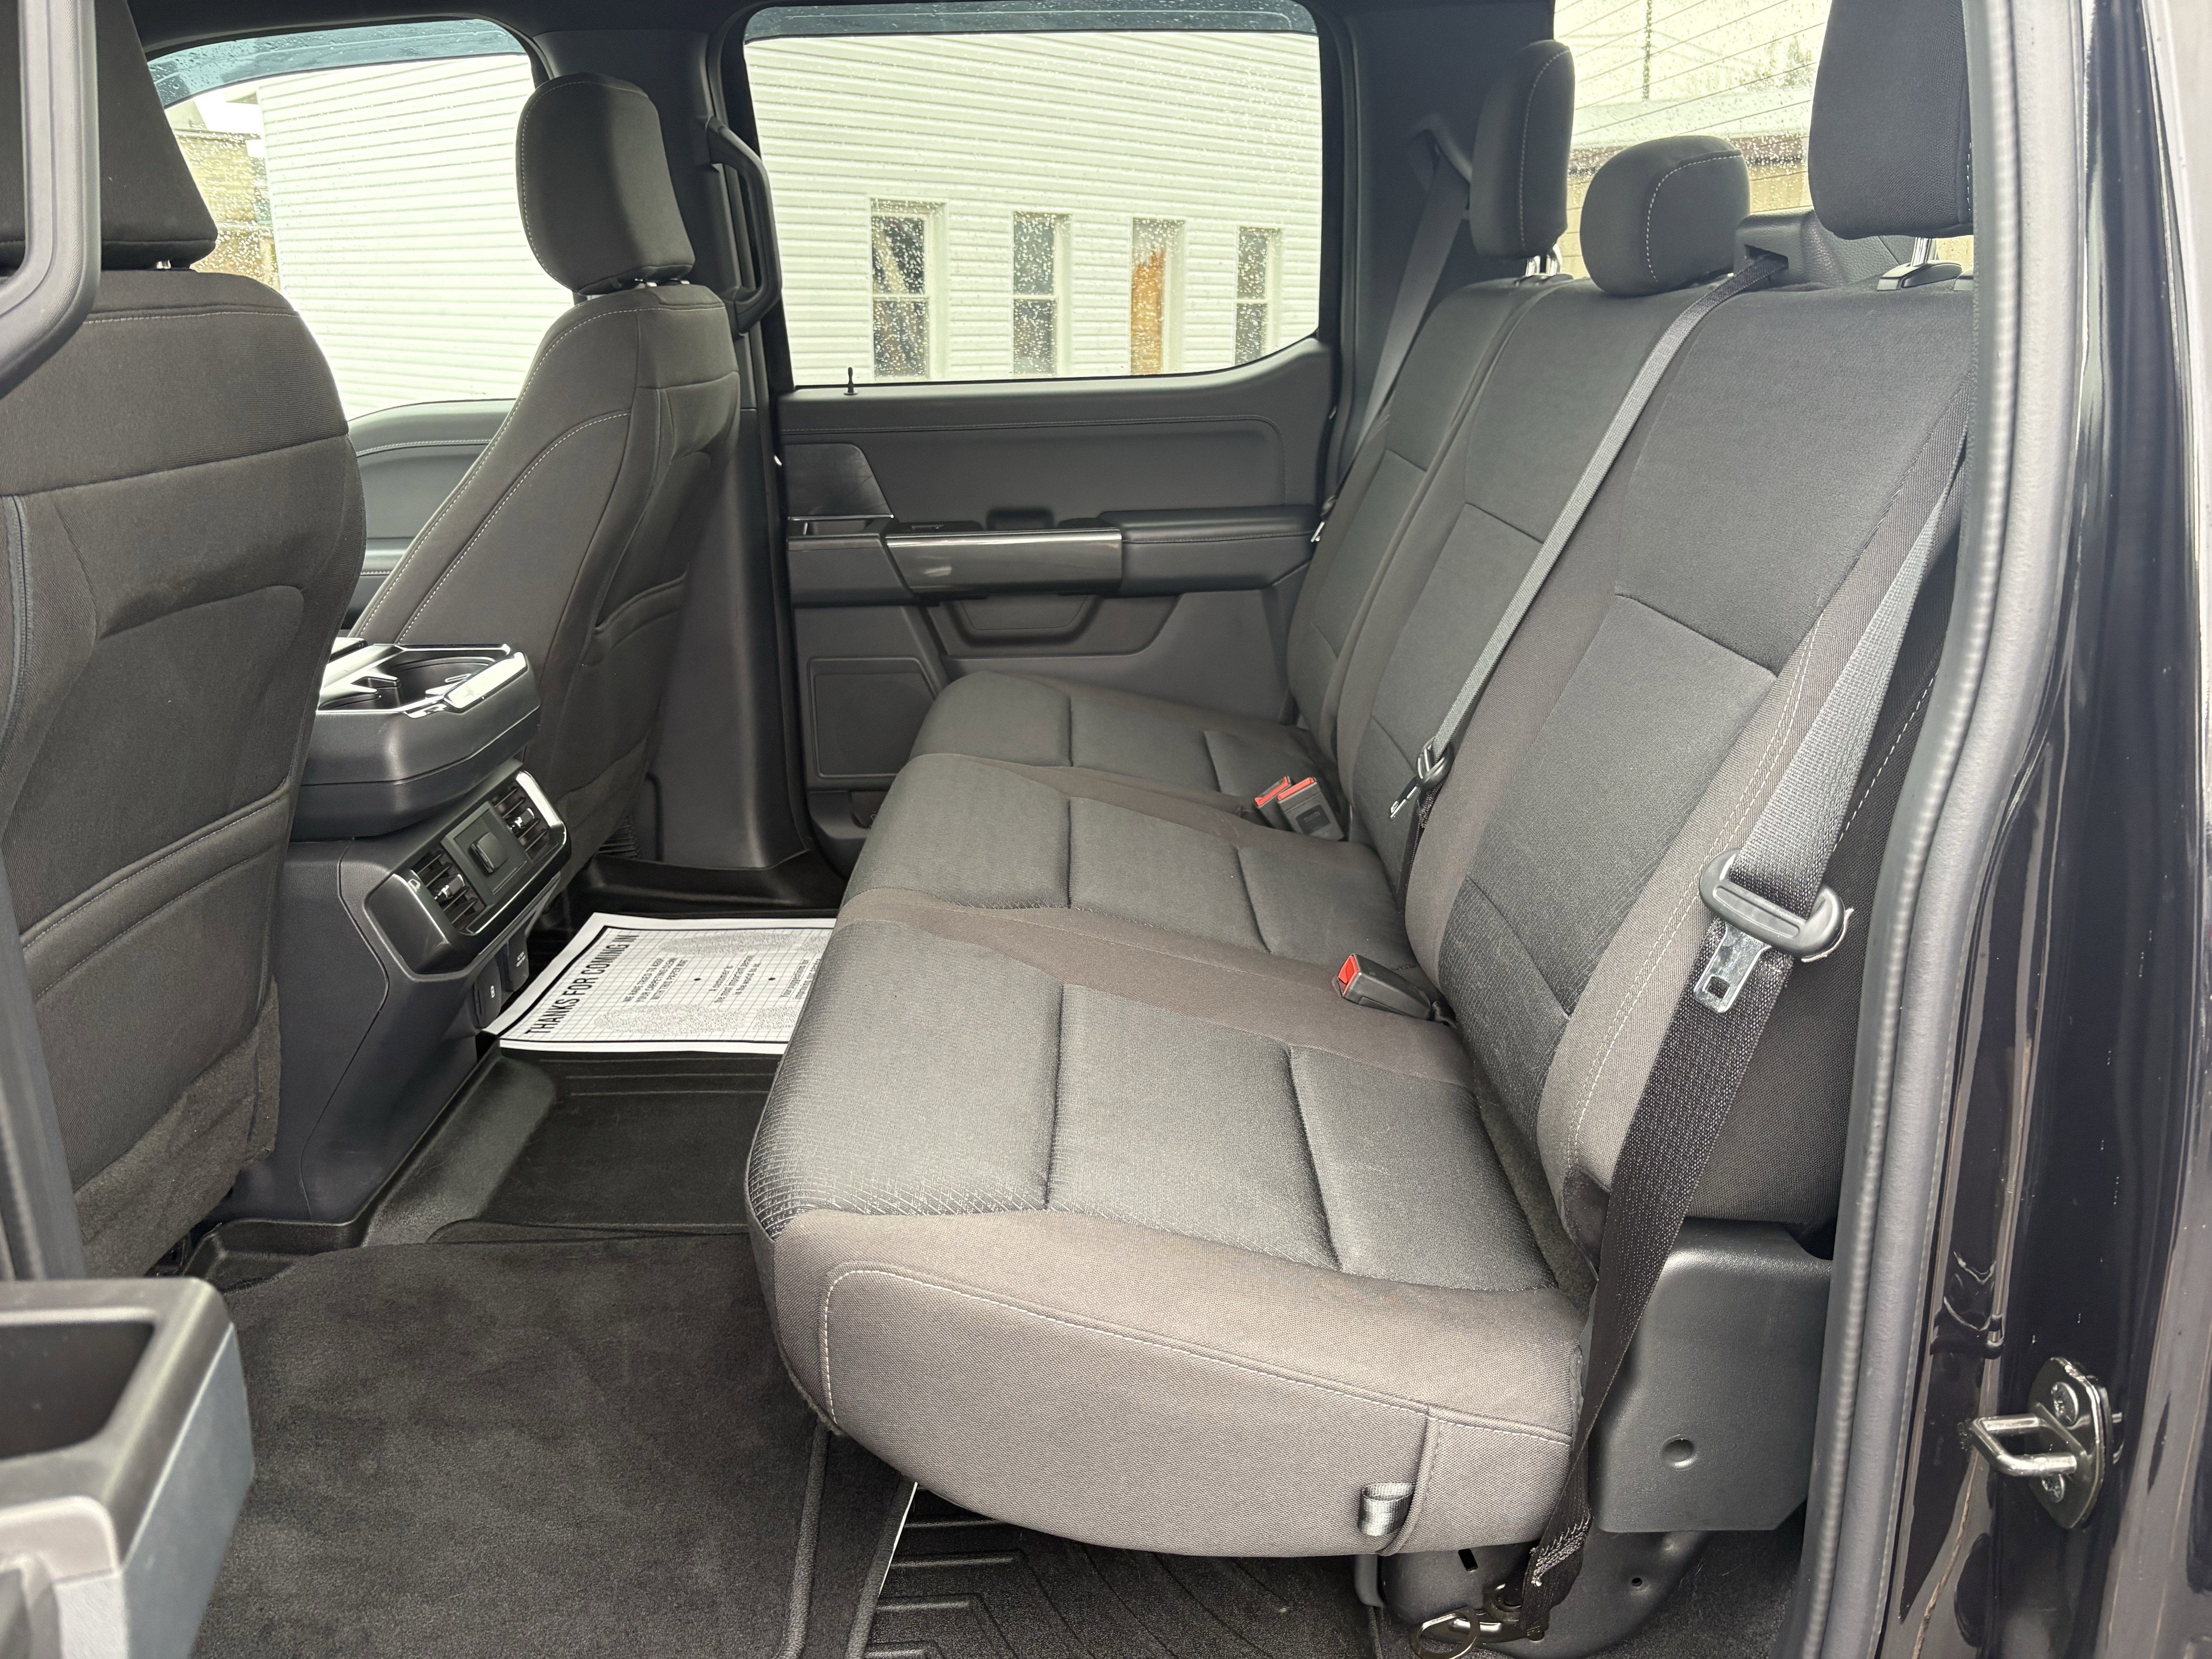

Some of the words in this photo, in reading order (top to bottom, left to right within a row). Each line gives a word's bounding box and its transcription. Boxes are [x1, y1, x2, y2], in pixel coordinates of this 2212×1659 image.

[666, 968, 682, 980] PAPER
[713, 968, 730, 988] customer
[728, 968, 746, 986] important
[524, 999, 580, 1034] THANKS
[562, 977, 599, 995] FOR
[581, 944, 630, 975] COMING
[635, 992, 651, 1002] YOUR
[645, 969, 668, 991] CARPETING
